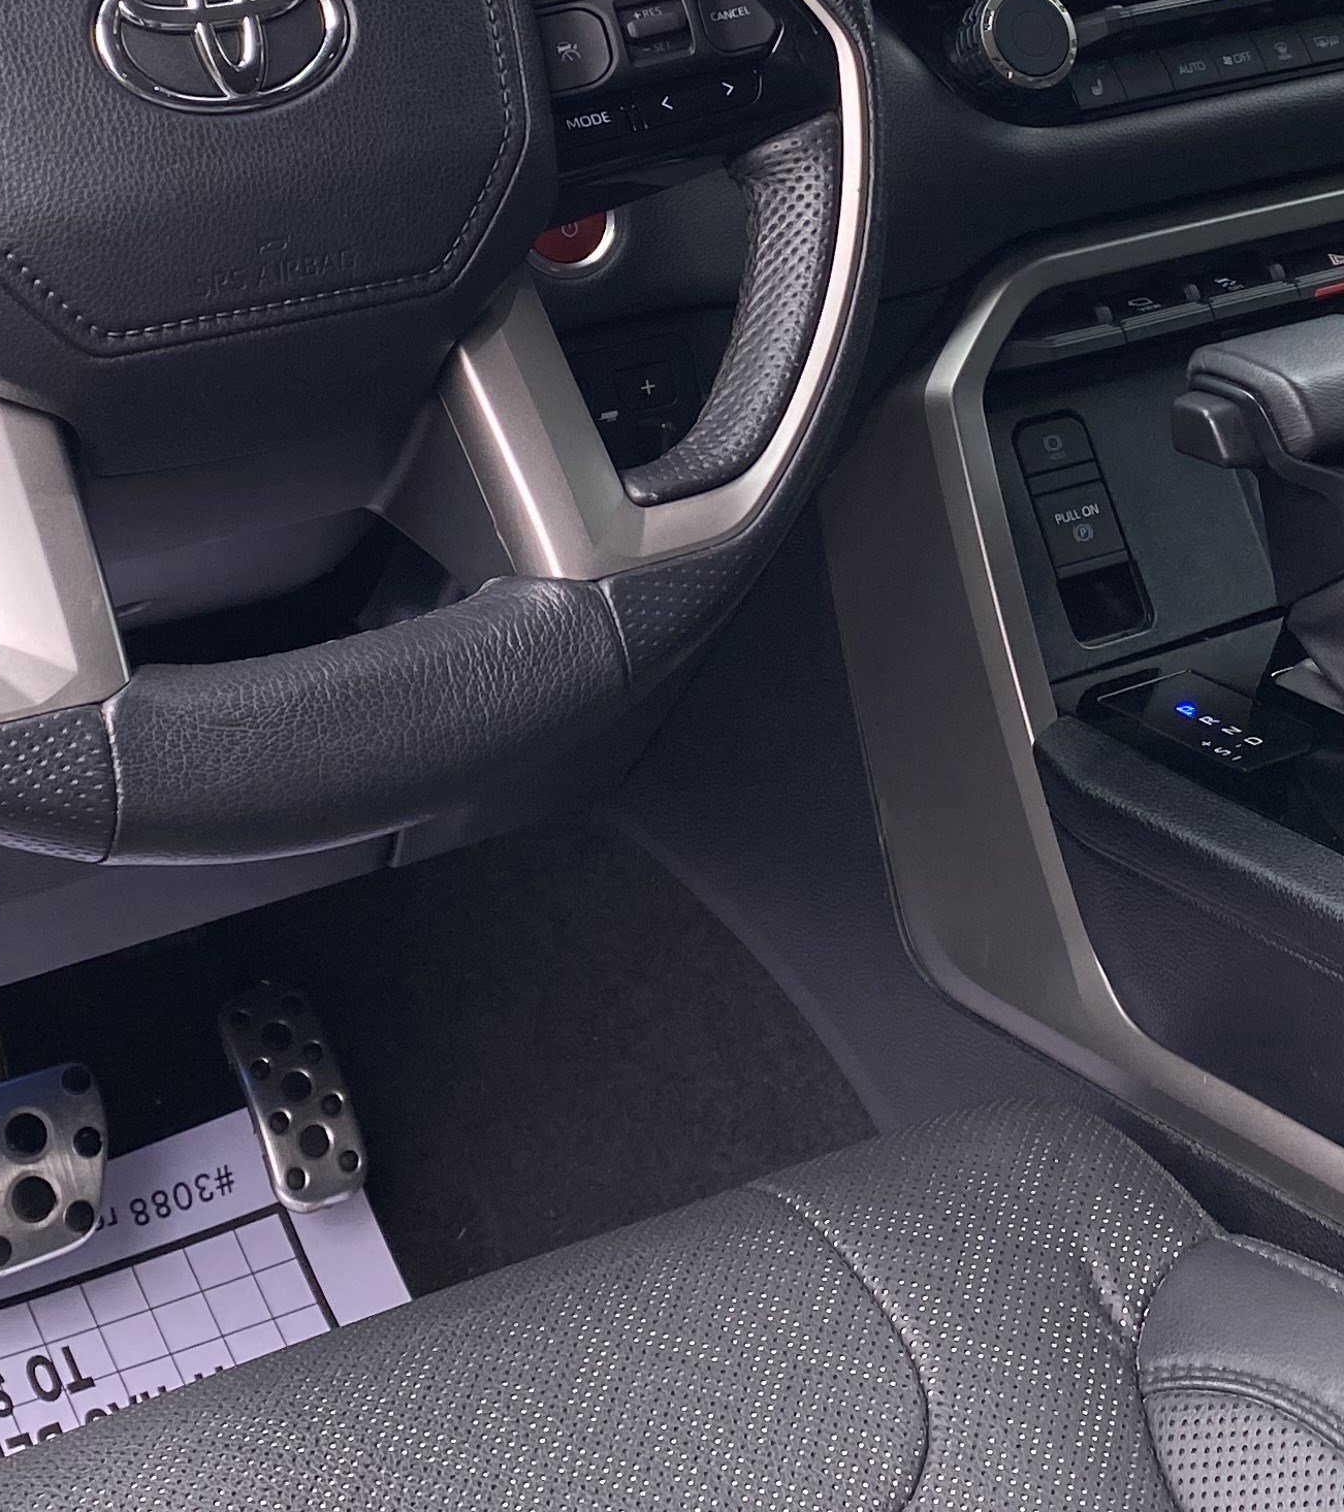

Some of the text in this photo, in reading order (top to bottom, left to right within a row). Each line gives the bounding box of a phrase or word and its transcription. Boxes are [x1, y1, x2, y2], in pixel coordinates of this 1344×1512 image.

[709, 5, 751, 22] CANCEL
[1232, 50, 1253, 65] OFF
[1178, 60, 1206, 76] AUTO
[565, 111, 612, 130] MODE
[1054, 503, 1100, 526] PULL ON
[1198, 715, 1221, 727] R
[1243, 736, 1264, 747] D
[129, 1164, 236, 1227] #3088
[25, 1345, 96, 1403] TO
